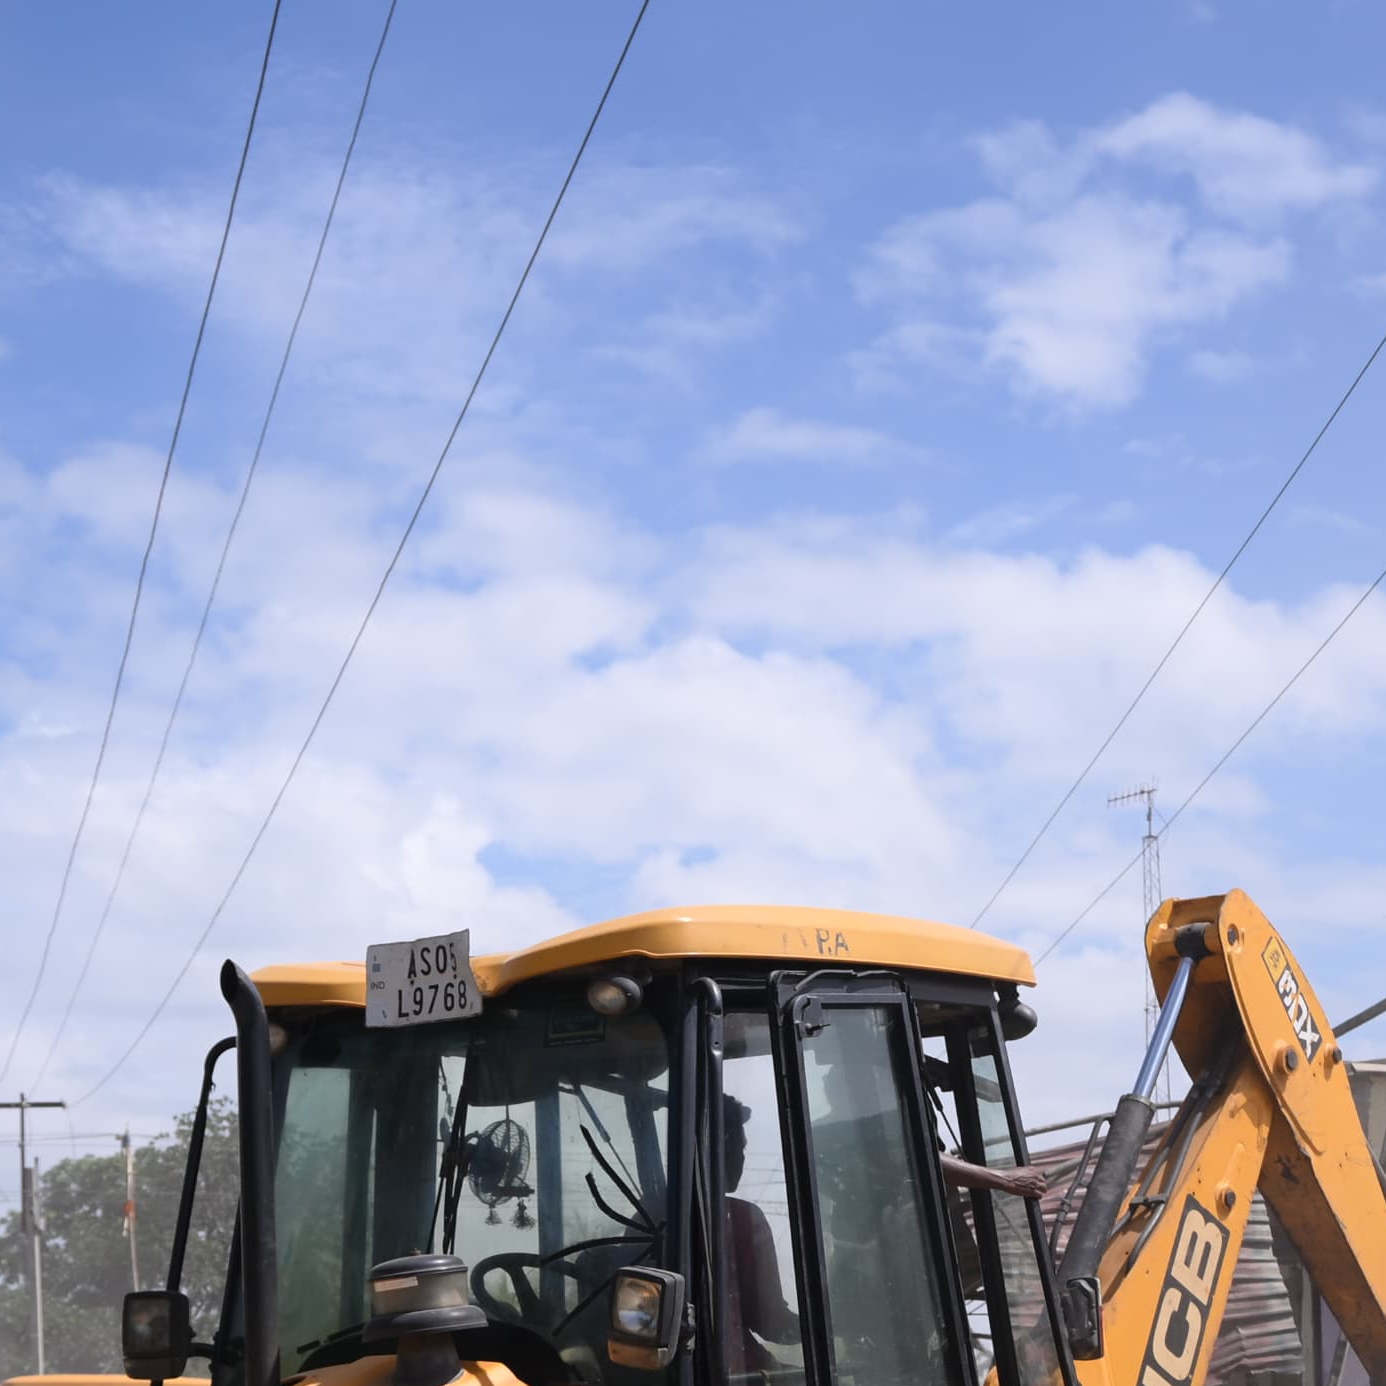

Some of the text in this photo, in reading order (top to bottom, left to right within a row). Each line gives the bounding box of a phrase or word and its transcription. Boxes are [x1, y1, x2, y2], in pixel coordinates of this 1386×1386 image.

[407, 941, 457, 979] AS05
[370, 981, 386, 990] IND
[398, 980, 467, 1018] L9768
